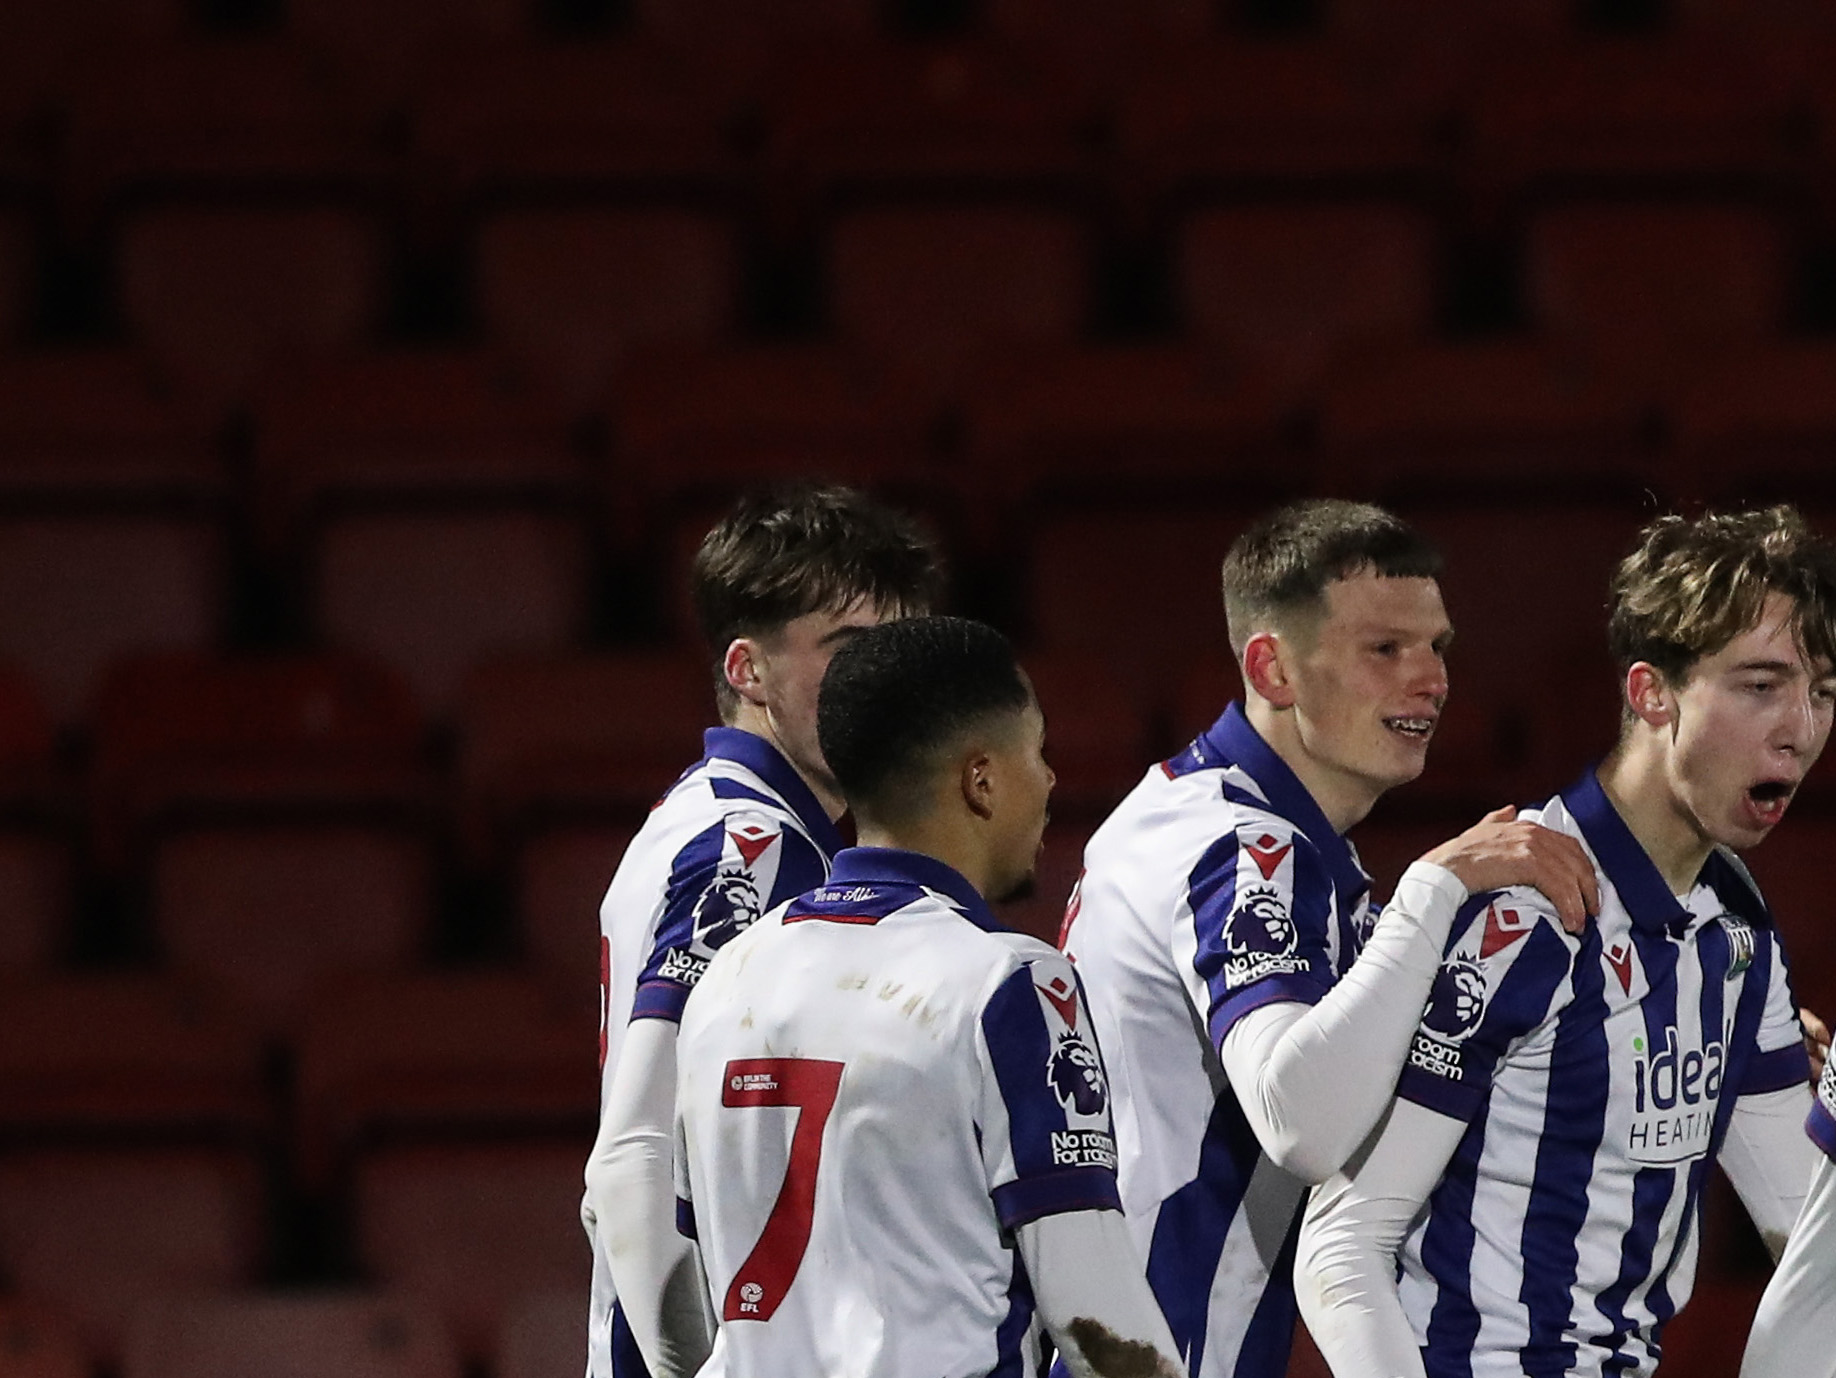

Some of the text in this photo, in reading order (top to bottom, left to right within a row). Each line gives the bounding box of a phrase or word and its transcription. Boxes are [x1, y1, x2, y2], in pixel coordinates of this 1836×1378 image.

[664, 946, 693, 968] No
[1224, 957, 1248, 976] No
[1412, 1035, 1461, 1066] oom
[1411, 1049, 1464, 1081] acism
[1051, 1131, 1080, 1150] No
[1628, 1111, 1714, 1149] HEATIN
[1053, 1147, 1081, 1165] for
[722, 1058, 845, 1322] 7
